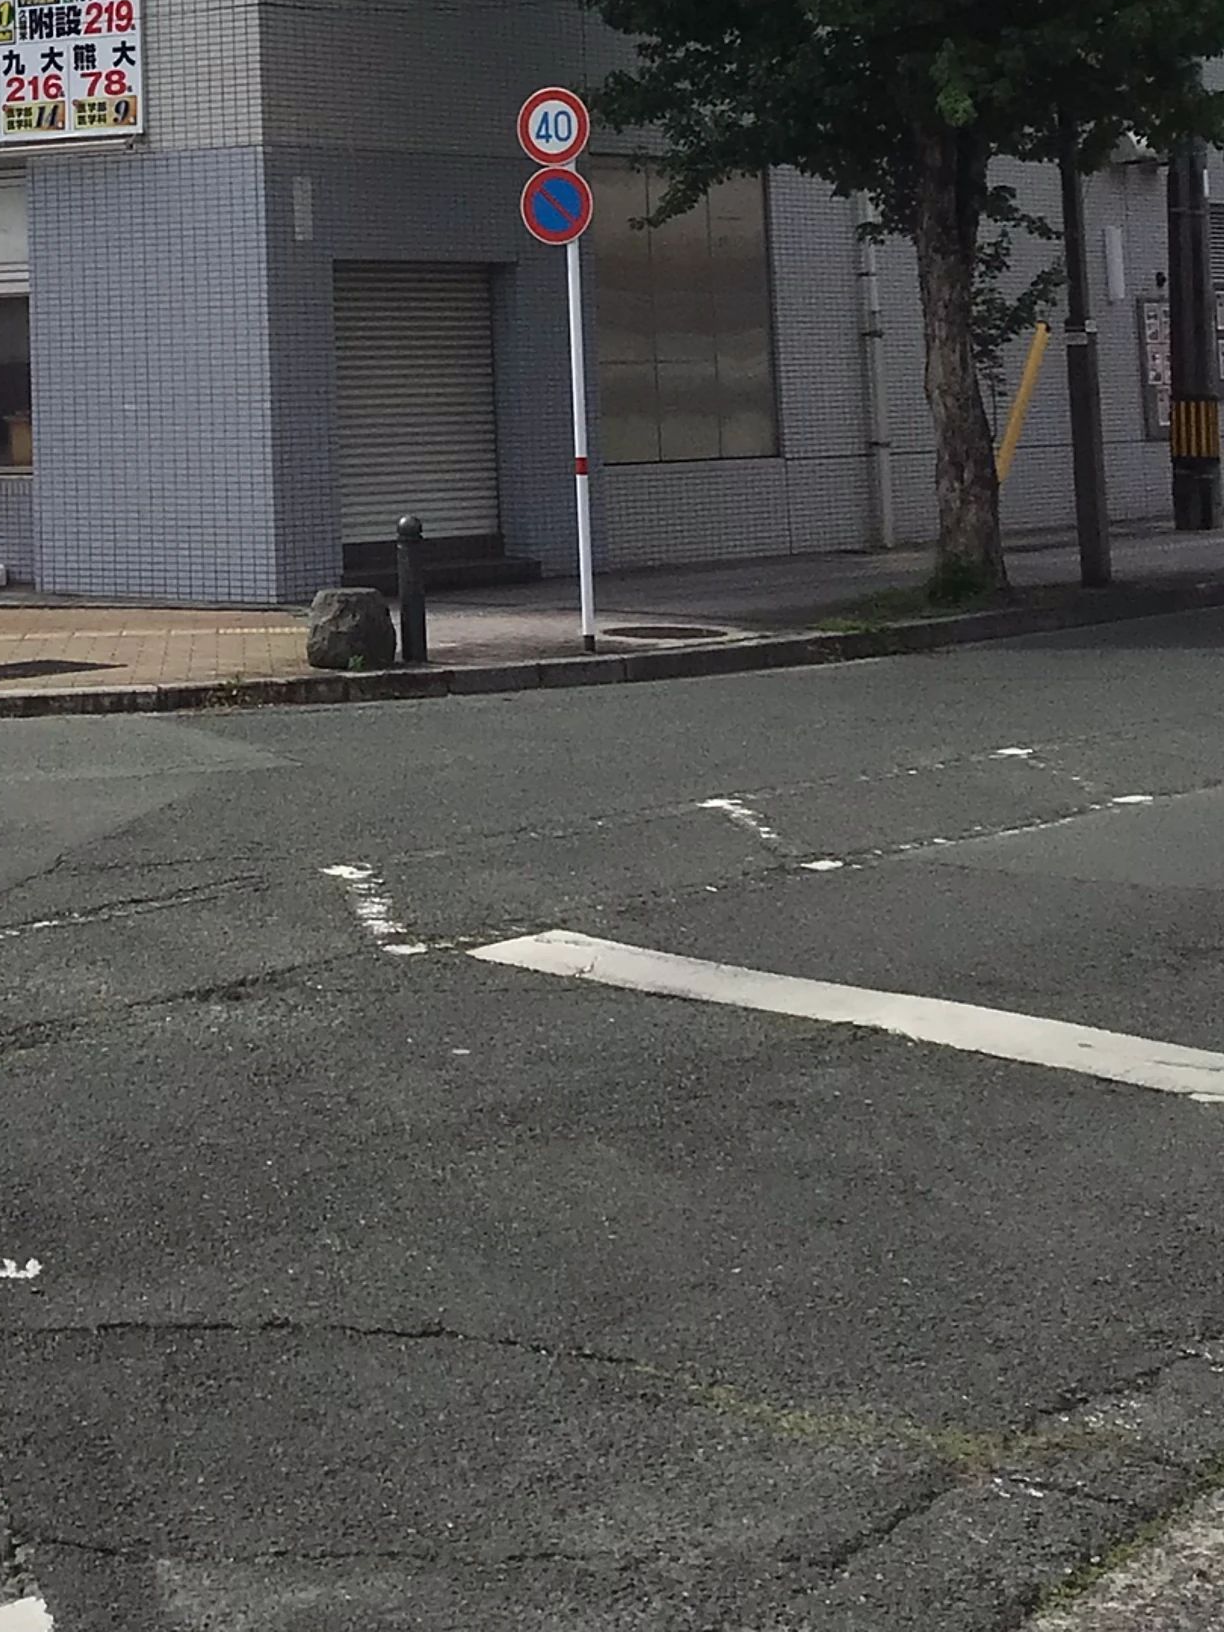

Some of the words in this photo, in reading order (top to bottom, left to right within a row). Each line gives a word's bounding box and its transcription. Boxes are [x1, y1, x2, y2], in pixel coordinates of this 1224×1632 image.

[83, 0, 134, 35] 219
[5, 72, 63, 102] 216
[80, 69, 128, 97] 78
[536, 110, 572, 144] 40
